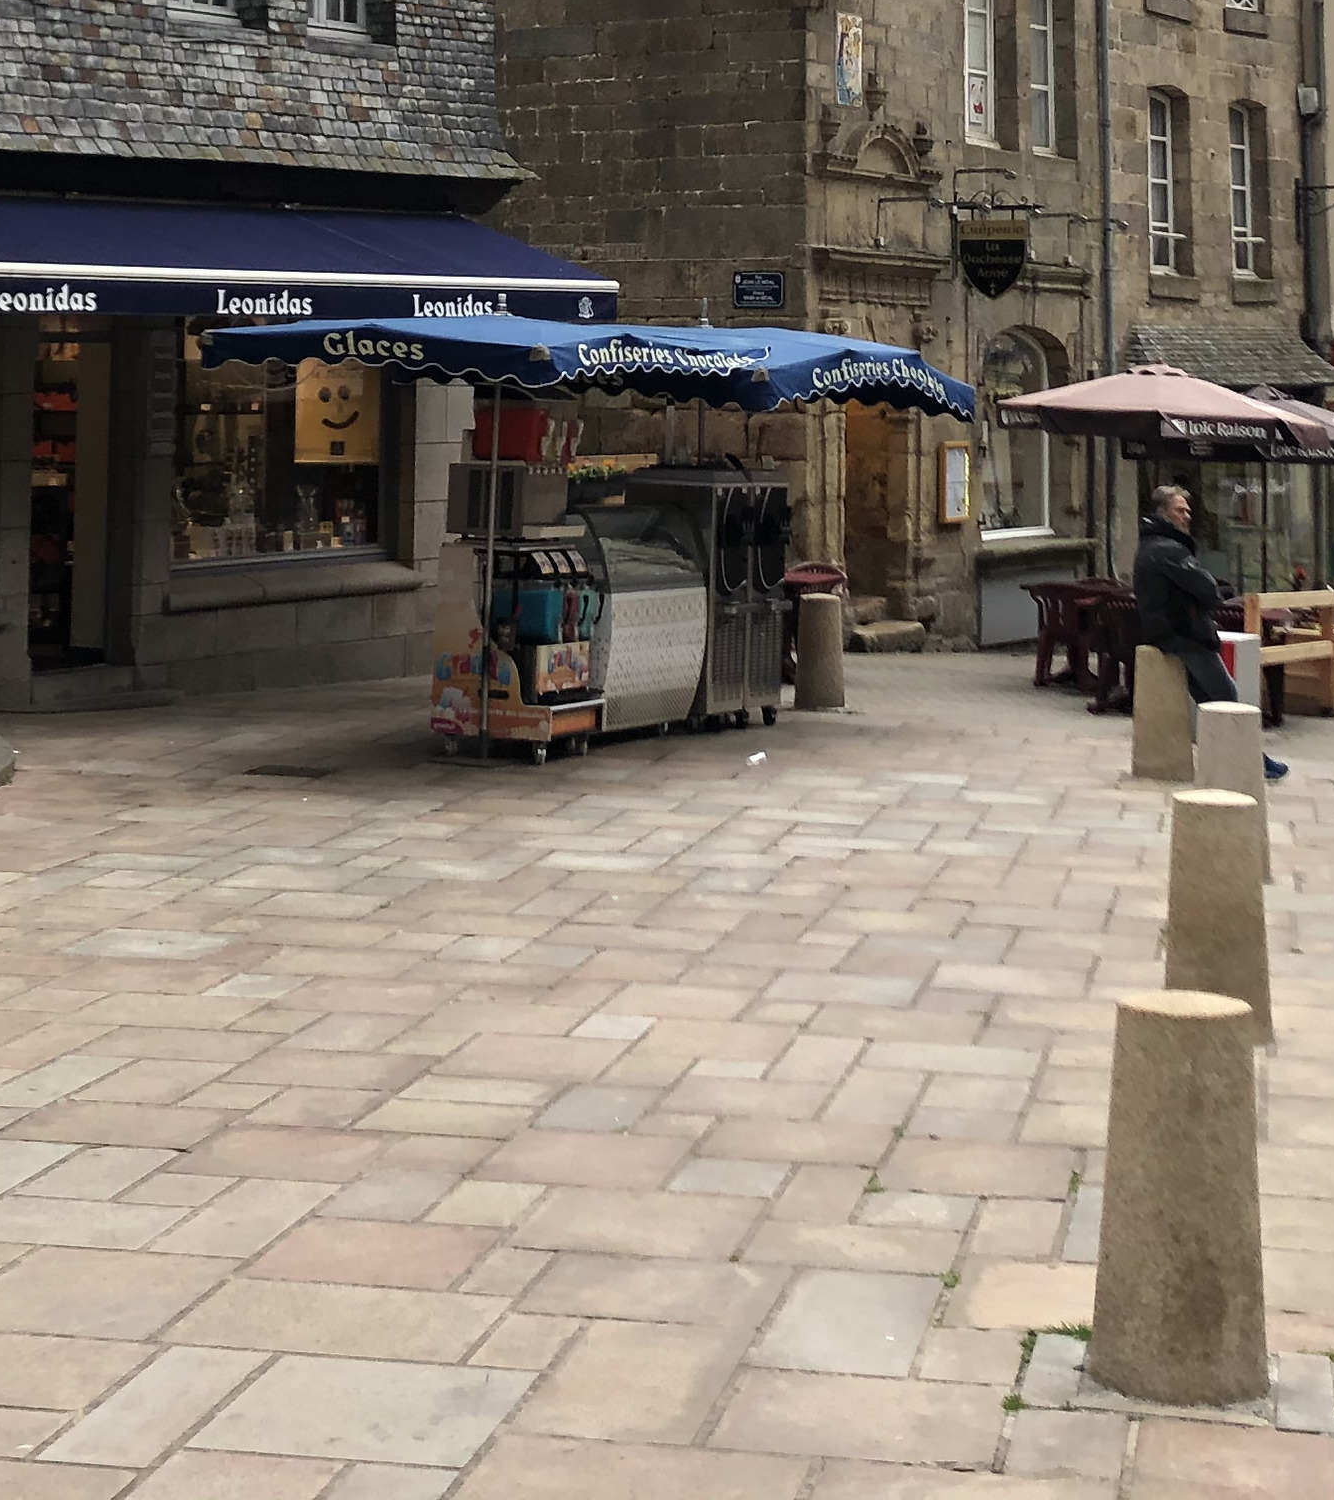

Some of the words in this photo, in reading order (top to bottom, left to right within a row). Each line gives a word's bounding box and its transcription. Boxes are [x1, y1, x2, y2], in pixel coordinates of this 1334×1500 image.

[217, 289, 313, 315] Leonidas
[412, 294, 494, 318] Leonidas
[323, 330, 425, 361] Glaces
[578, 339, 674, 367] Confiseries
[812, 356, 891, 388] Confiseries
[1217, 422, 1267, 440] Raison
